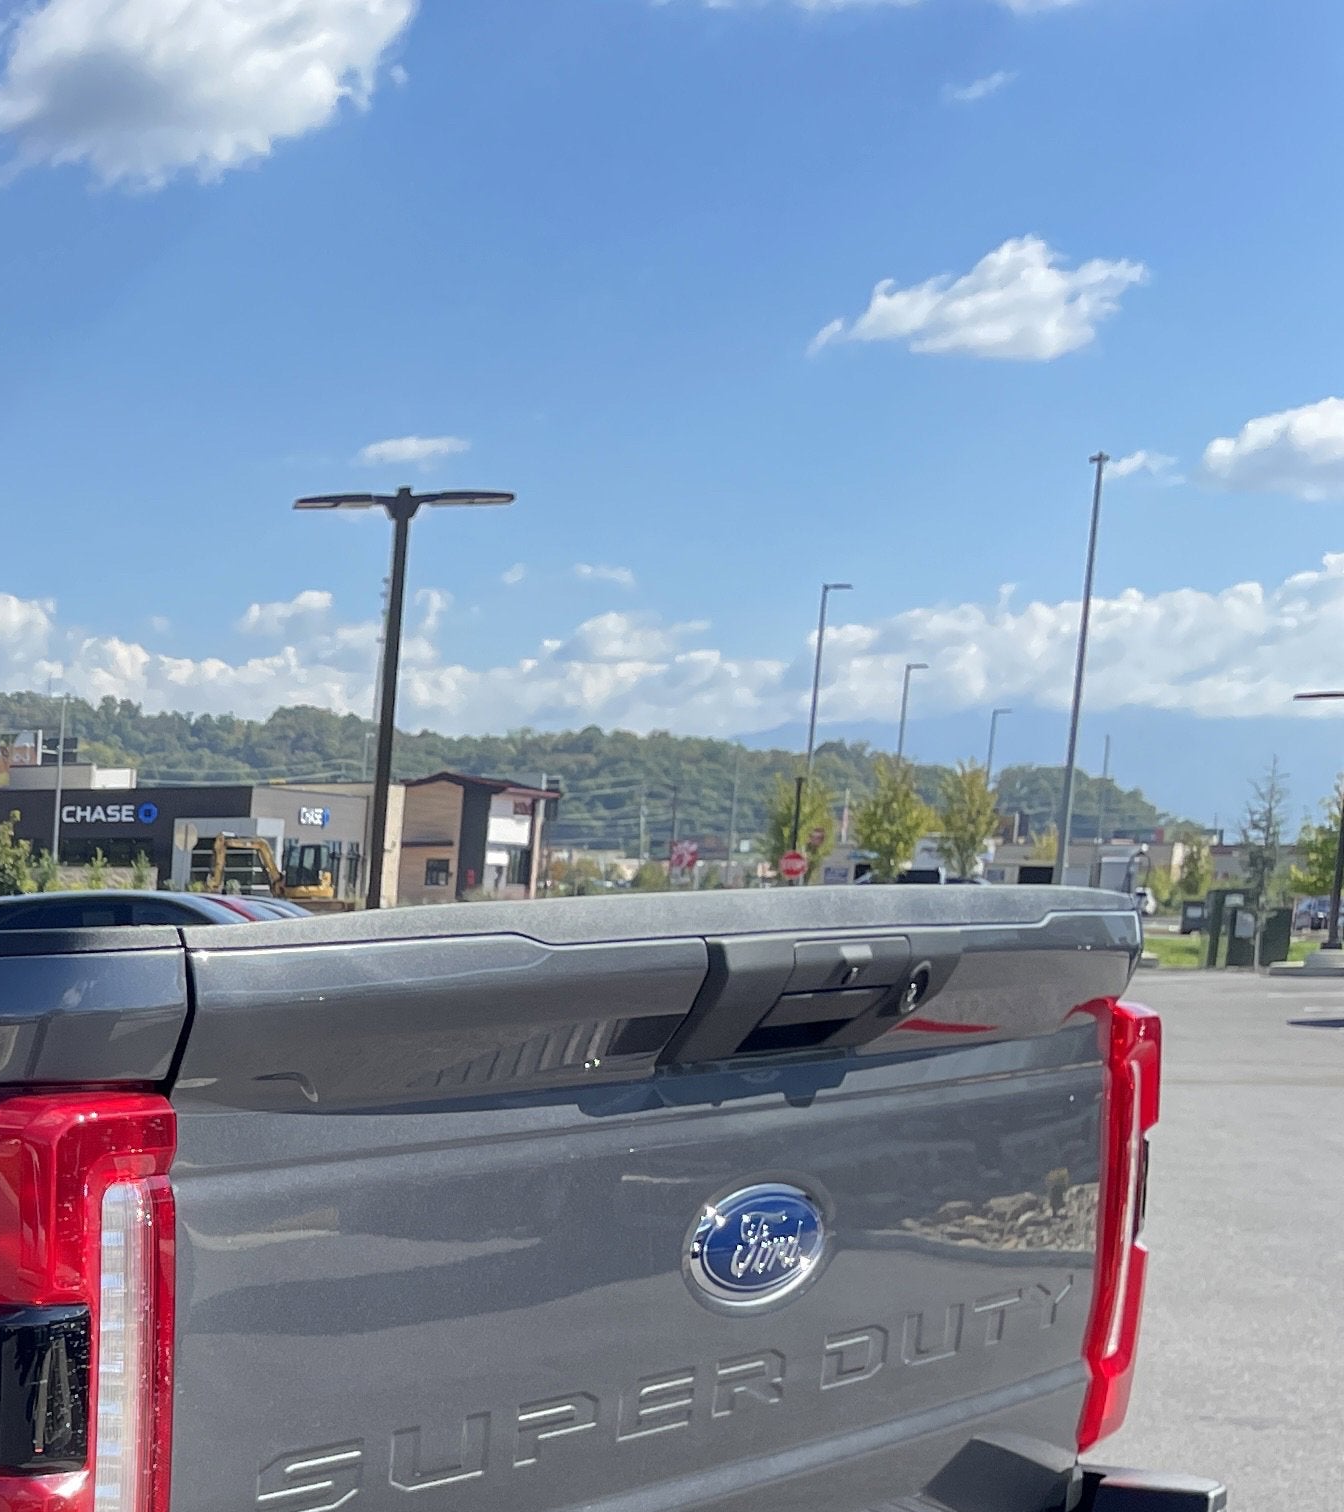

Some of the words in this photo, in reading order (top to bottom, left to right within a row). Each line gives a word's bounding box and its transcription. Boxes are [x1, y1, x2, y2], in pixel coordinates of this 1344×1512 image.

[62, 805, 135, 823] CHASE
[730, 1209, 805, 1279] Ford
[820, 1274, 1072, 1391] DUTY
